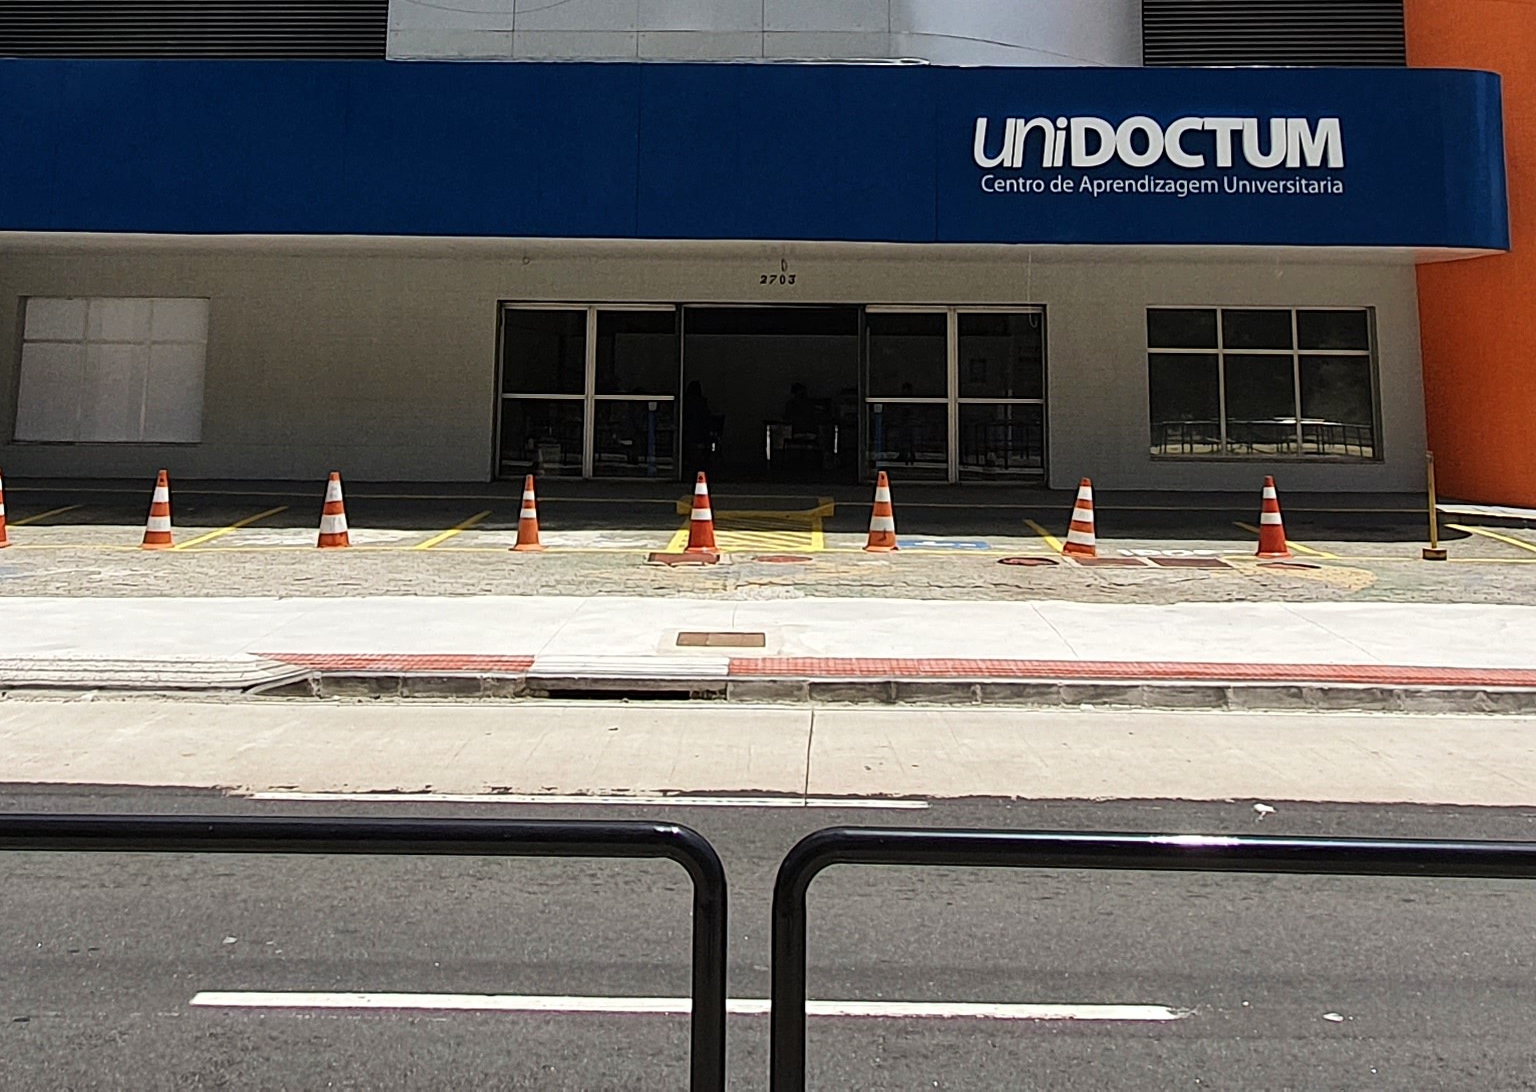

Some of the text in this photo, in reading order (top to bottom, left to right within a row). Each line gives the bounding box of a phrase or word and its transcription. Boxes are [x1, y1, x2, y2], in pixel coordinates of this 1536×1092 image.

[980, 174, 1344, 198] Centro de Aprendizagem Universitaria
[759, 274, 797, 285] 2703
